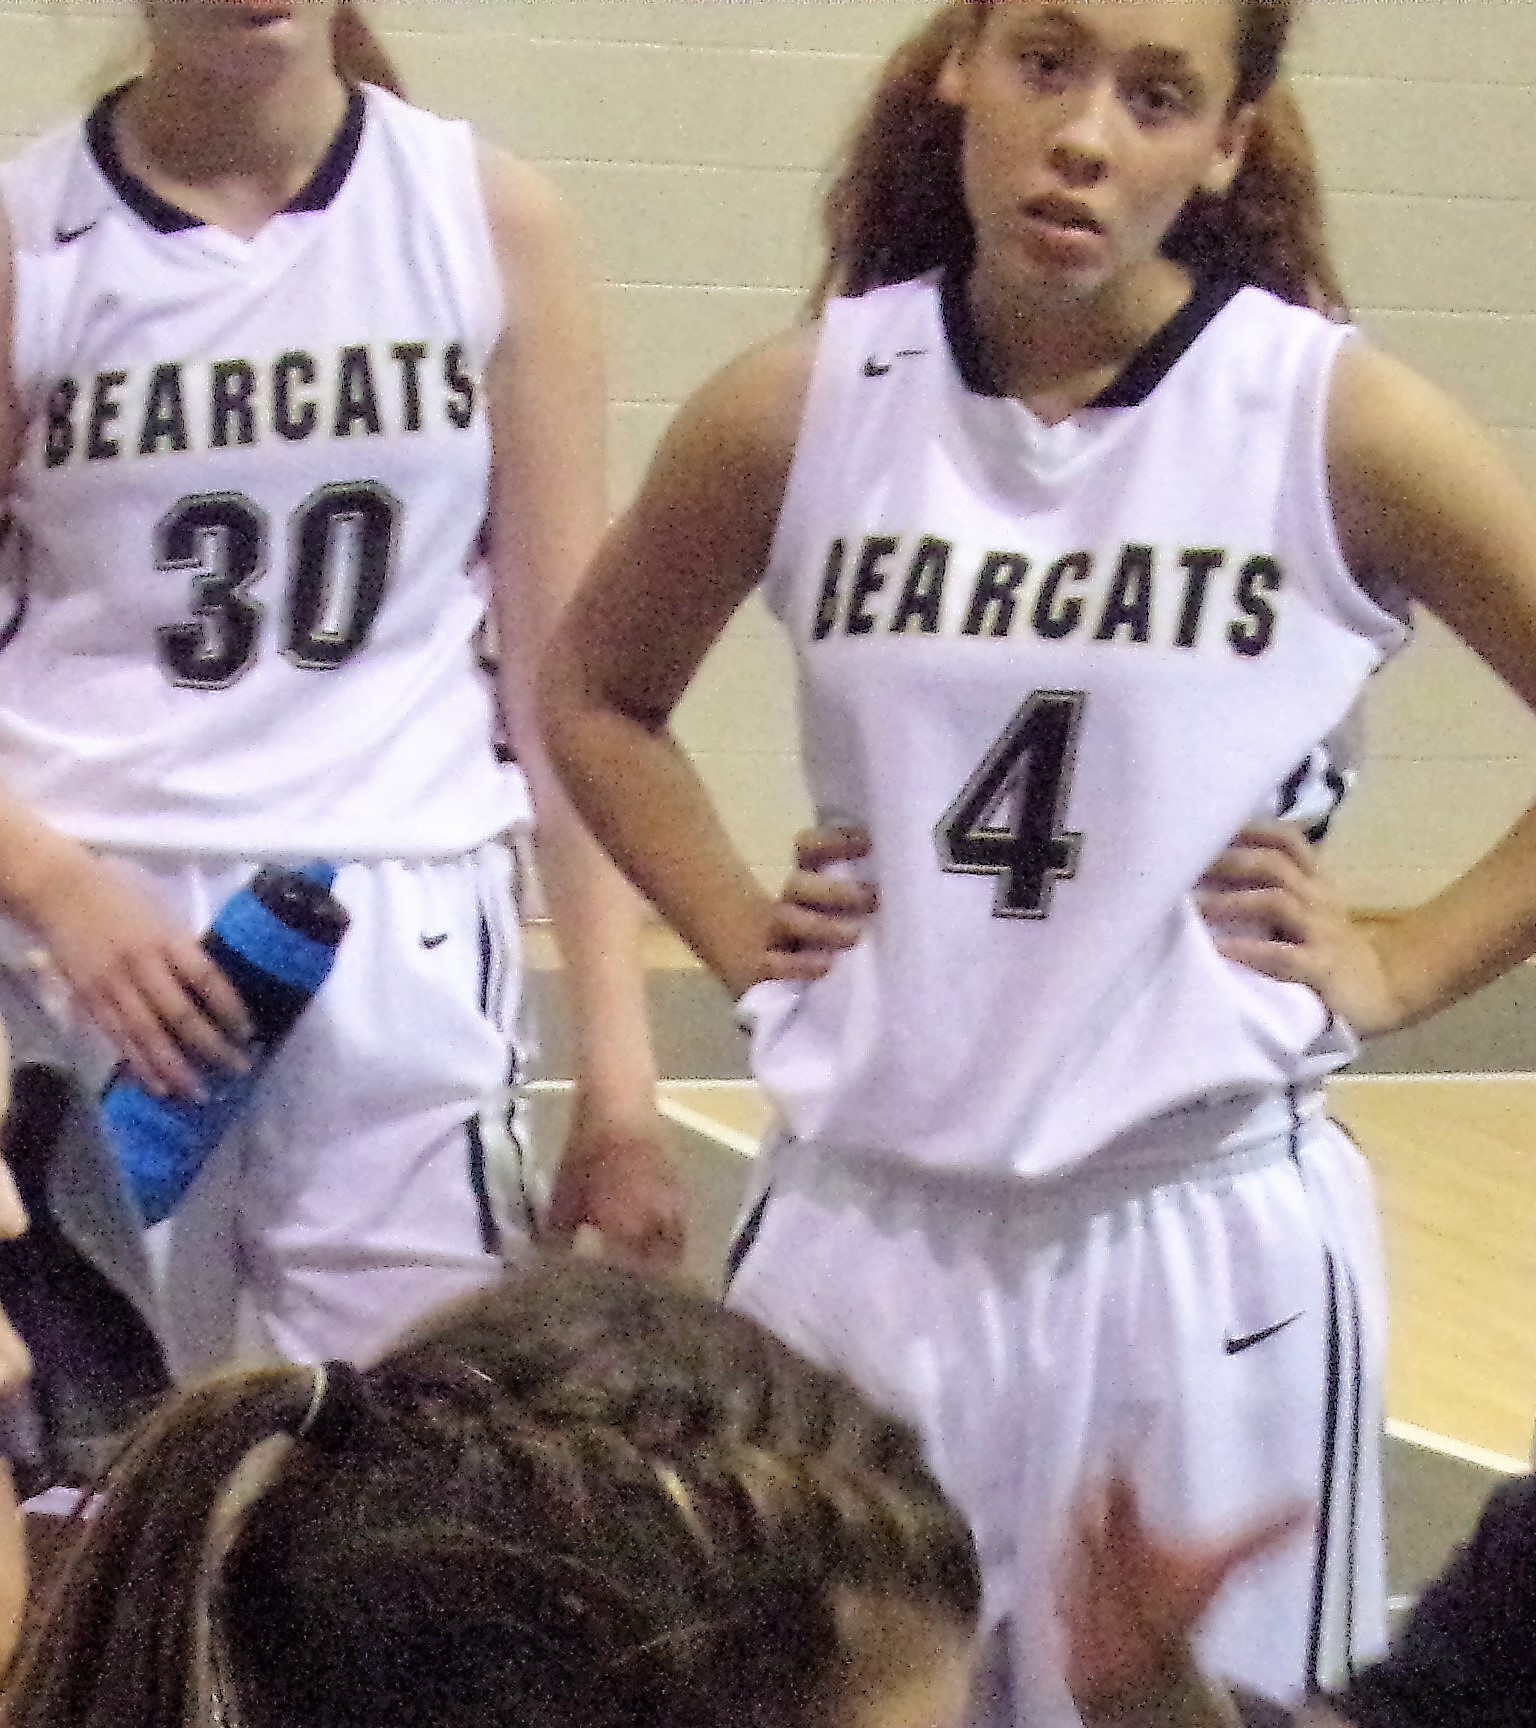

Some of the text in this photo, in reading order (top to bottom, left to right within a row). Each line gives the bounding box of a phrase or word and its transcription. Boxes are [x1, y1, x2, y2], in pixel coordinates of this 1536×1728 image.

[43, 340, 474, 467] BEARCATS
[155, 479, 402, 691] 30
[936, 688, 1086, 920] 4
